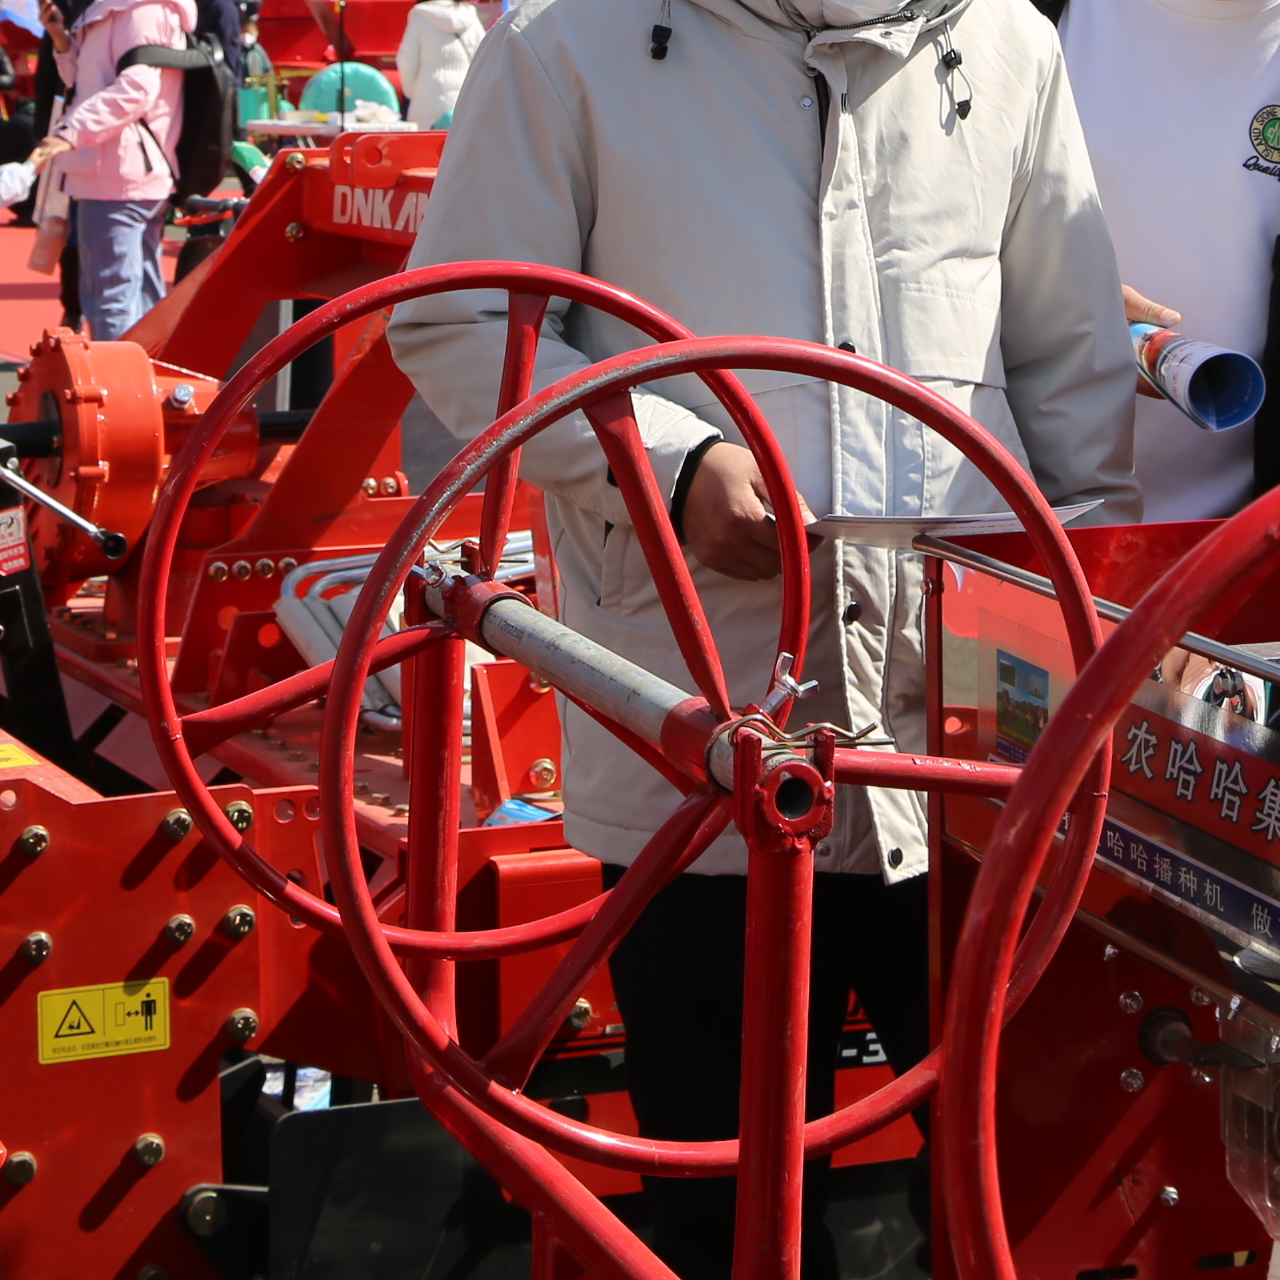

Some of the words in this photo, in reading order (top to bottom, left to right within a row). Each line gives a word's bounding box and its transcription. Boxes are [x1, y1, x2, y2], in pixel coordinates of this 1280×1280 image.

[1255, 107, 1278, 126] STONE
[1096, 830, 1225, 913] 哈哈播种机
